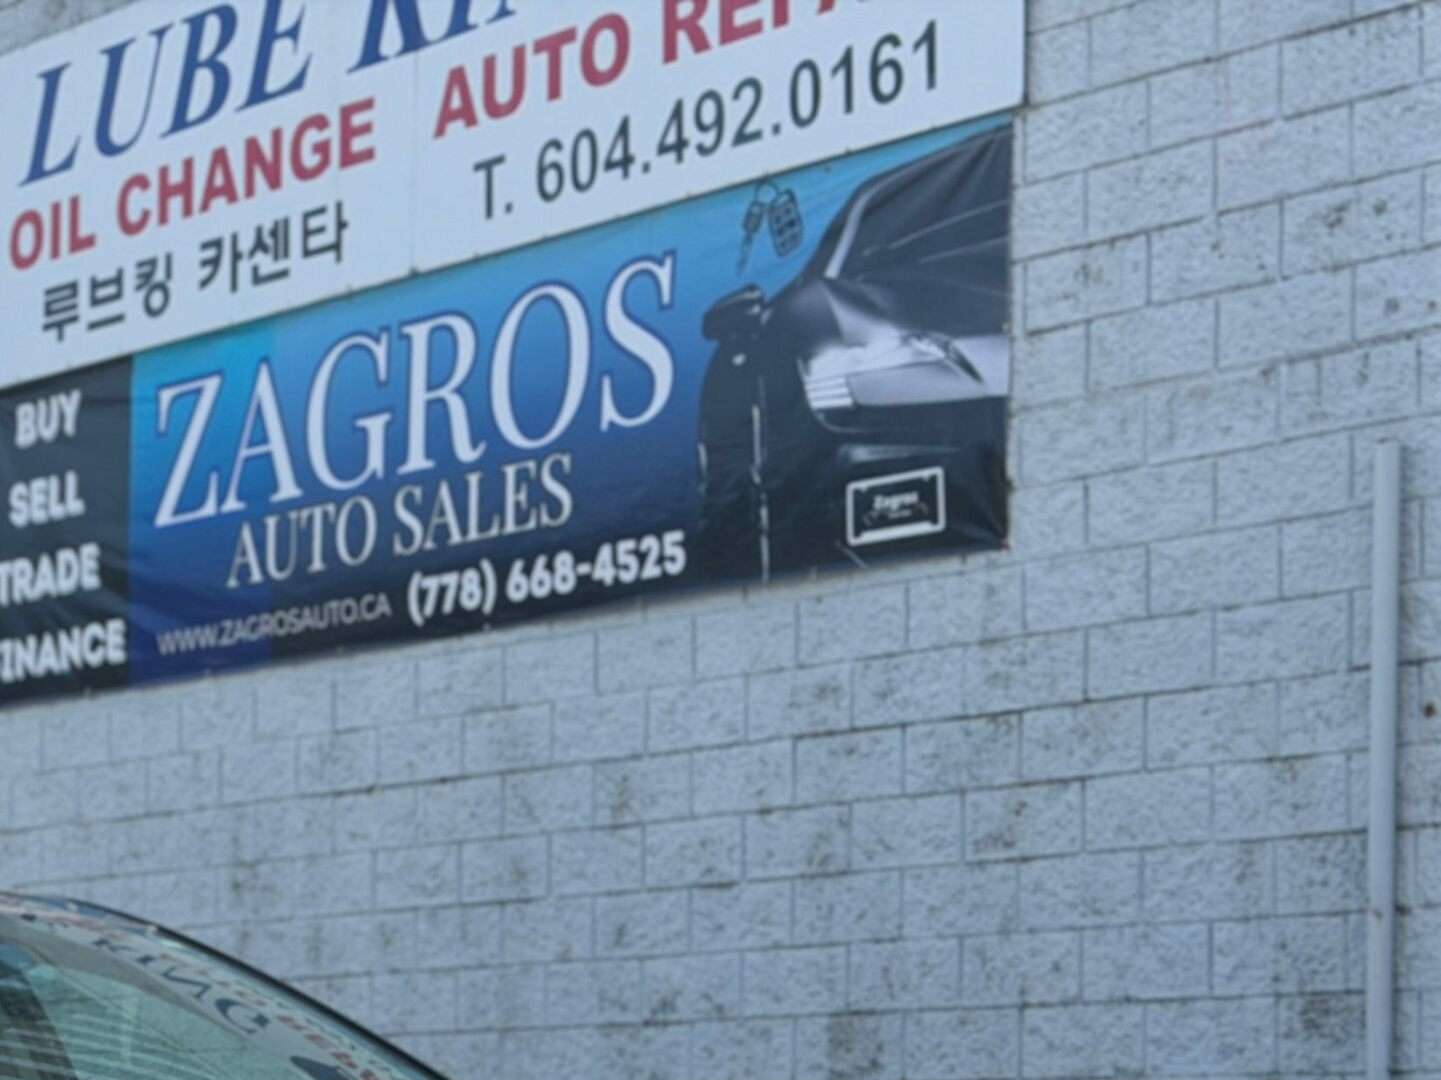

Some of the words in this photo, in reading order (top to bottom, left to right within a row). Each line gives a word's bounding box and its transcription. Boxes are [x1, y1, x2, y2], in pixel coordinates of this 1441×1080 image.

[18, 0, 312, 186] LUBE
[433, 12, 631, 139] AUTO
[473, 154, 513, 220] T.
[536, 19, 937, 203] 604.492.0161
[9, 195, 95, 270] OIL
[116, 97, 376, 236] CHANGE
[41, 252, 174, 342] 루브킹
[198, 201, 349, 292] 카센타
[15, 390, 81, 449] BUY
[155, 250, 676, 527] ZAGROS
[8, 471, 85, 527] SELL
[226, 496, 378, 588] AUTO
[393, 454, 573, 556] SALES
[157, 593, 392, 656] WWW.ZAGROSAUTO.CA
[408, 559, 497, 627] (778)
[506, 532, 687, 603] 668-4525
